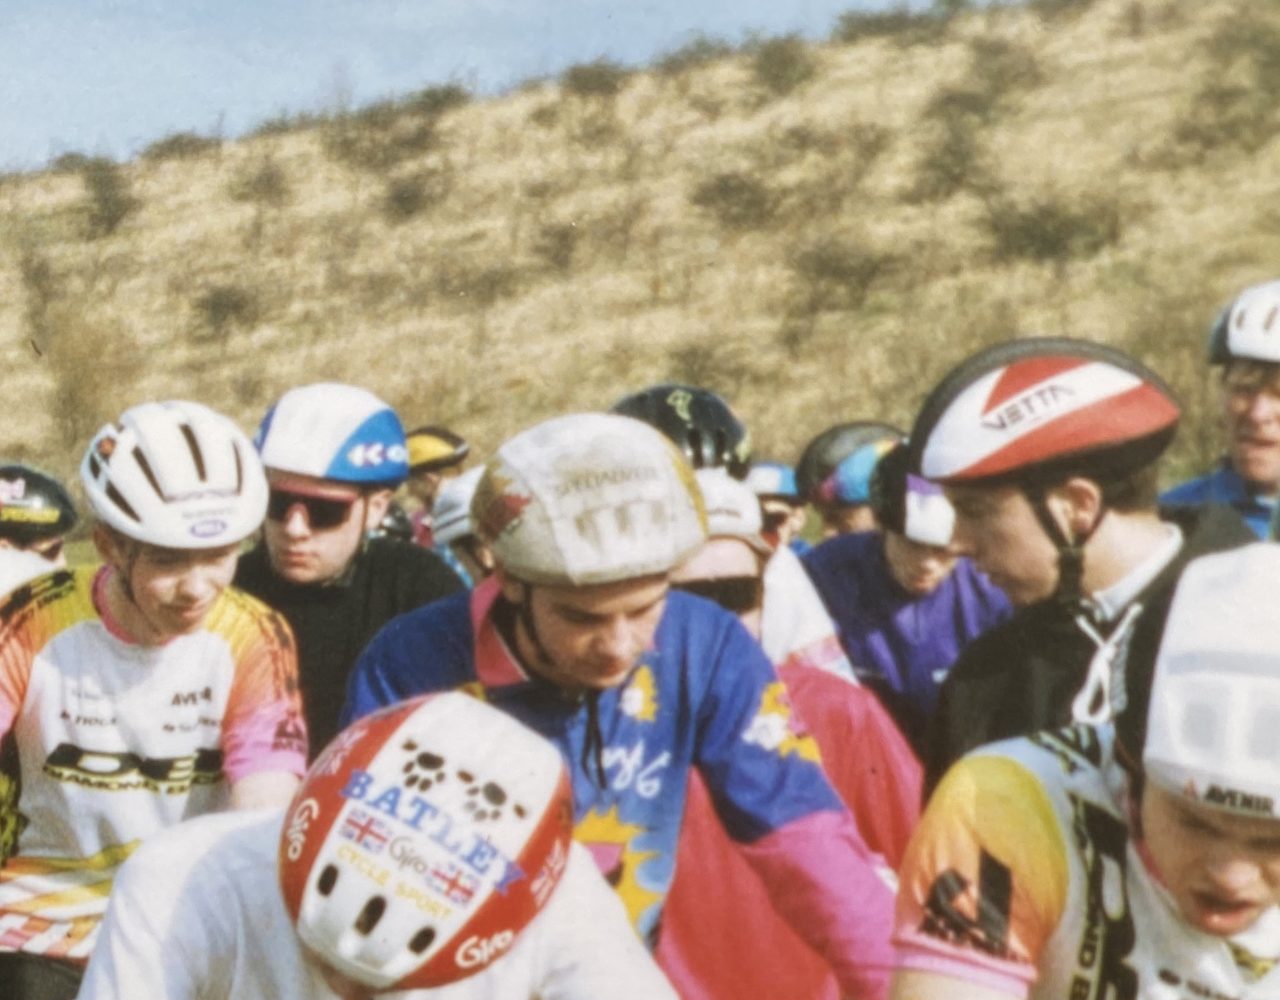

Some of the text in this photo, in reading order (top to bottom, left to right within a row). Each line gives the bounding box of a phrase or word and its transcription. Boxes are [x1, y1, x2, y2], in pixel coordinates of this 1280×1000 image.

[287, 797, 320, 862] Giro
[338, 769, 526, 896] BATLEY
[388, 835, 429, 875] Giro
[454, 928, 515, 969] Giro
